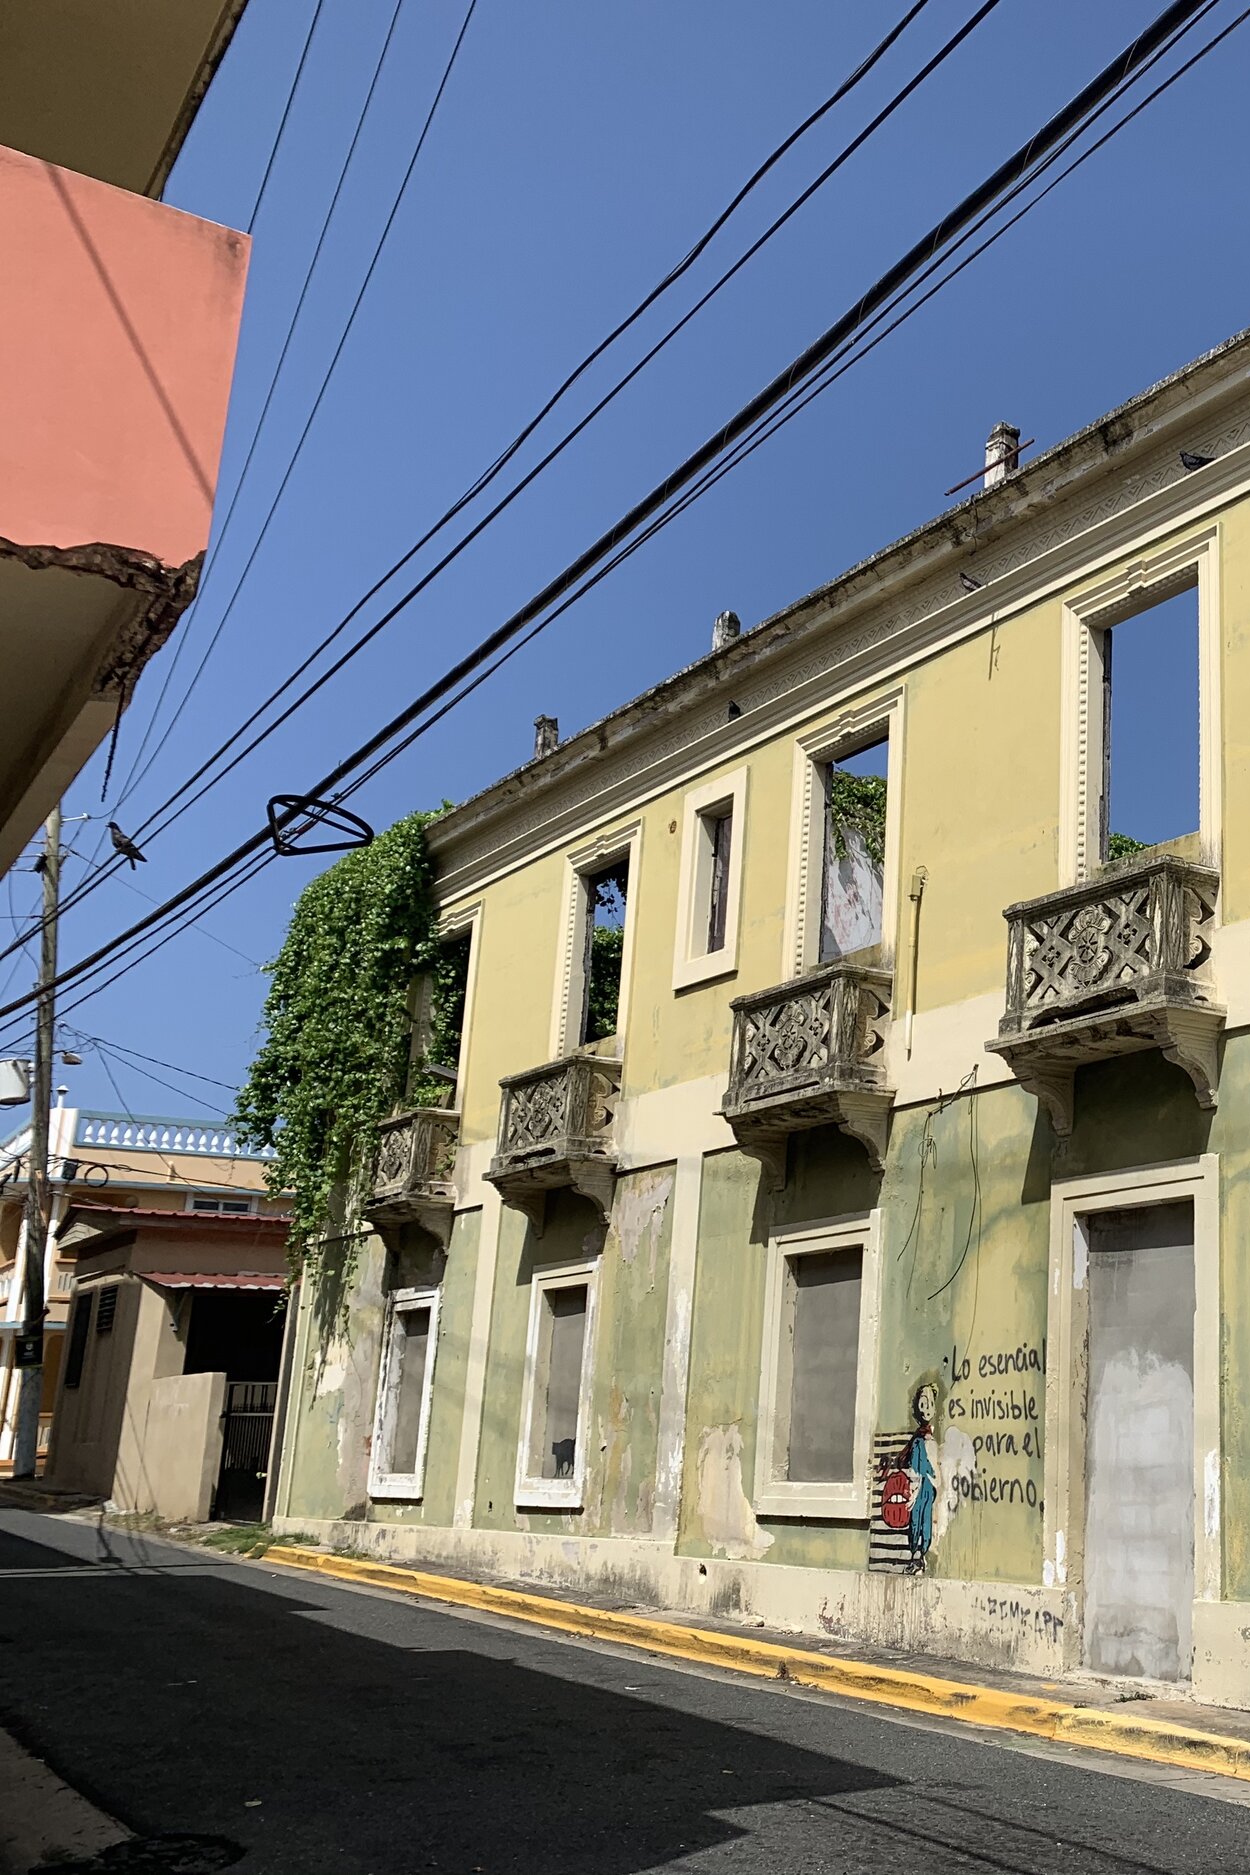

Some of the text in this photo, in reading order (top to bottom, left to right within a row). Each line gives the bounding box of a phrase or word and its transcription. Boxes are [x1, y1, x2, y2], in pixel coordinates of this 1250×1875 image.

[951, 1338, 1046, 1381] Lo esencial
[948, 1389, 1038, 1420] es invisible
[972, 1426, 1041, 1469] para el
